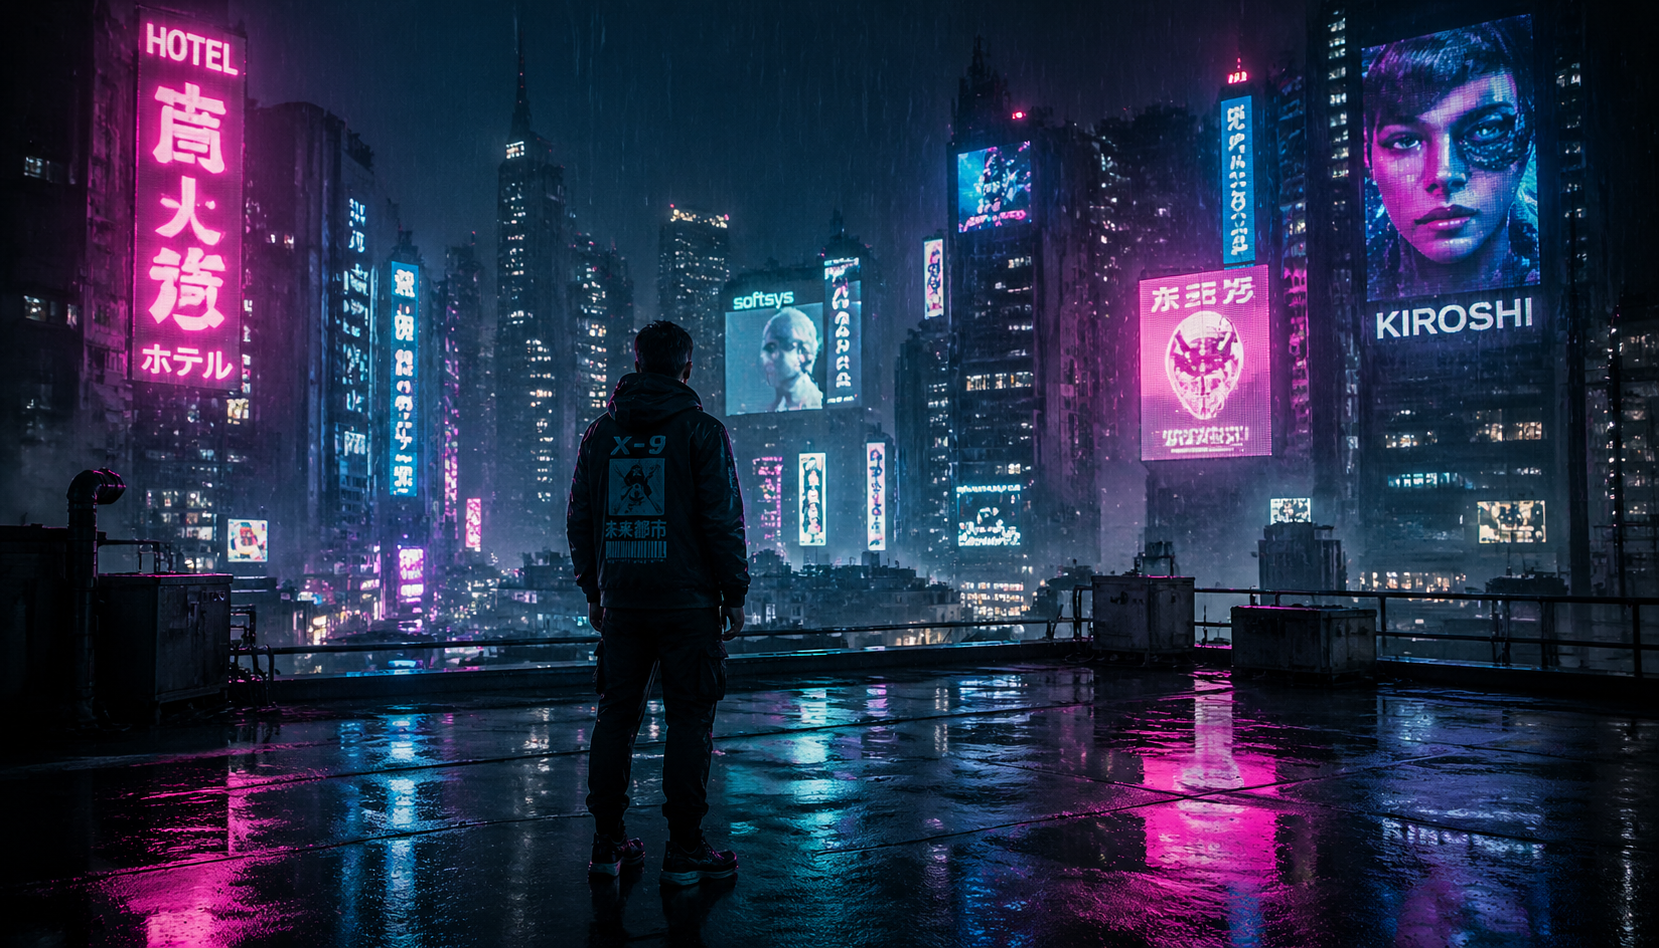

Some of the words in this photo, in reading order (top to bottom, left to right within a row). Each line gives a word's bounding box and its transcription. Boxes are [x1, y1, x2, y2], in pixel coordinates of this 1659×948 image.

[146, 22, 239, 76] HOTEL
[733, 291, 795, 310] softsys
[1376, 297, 1533, 340] KIROSHI
[141, 343, 234, 380] ホテル
[610, 435, 667, 456] X-9
